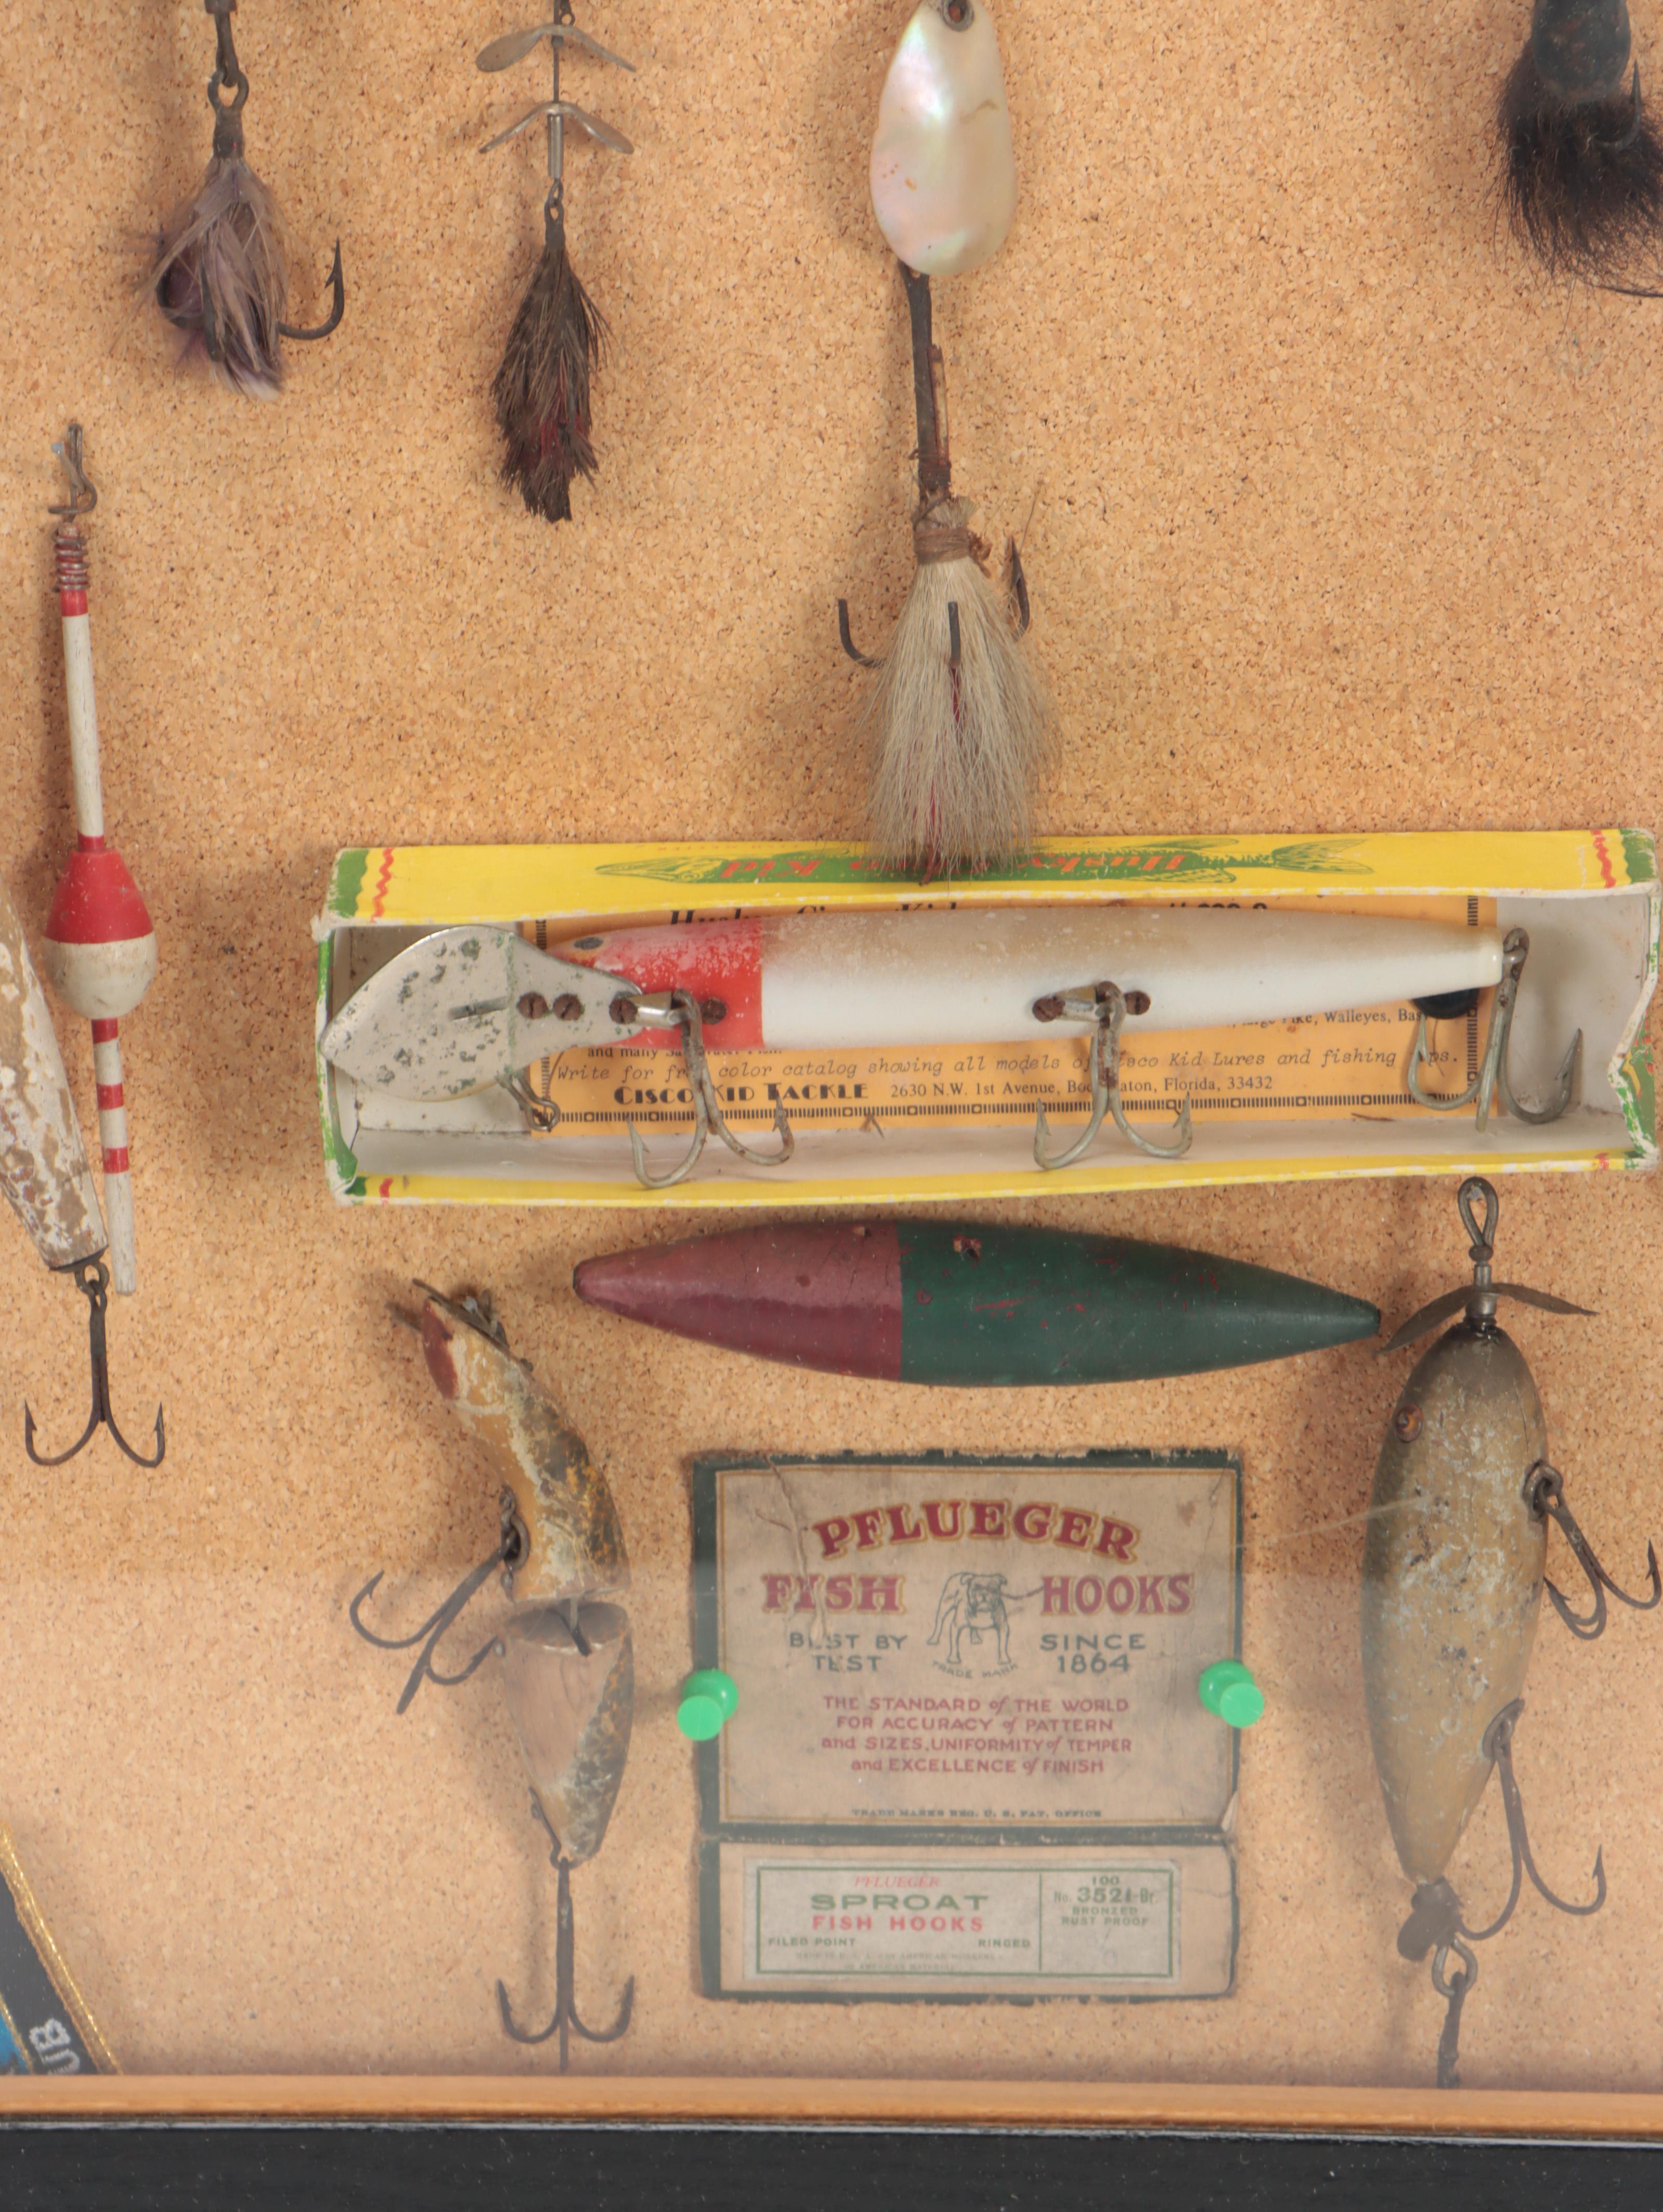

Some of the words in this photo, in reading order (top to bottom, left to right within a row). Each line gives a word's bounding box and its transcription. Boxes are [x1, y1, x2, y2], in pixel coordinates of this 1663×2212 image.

[720, 859, 823, 878] Kid
[1325, 1010, 1391, 1025] Walleyes,
[1398, 1008, 1427, 1021] Bas
[588, 1047, 613, 1058] and
[558, 1064, 610, 1080] Write
[623, 1066, 653, 1084] for
[665, 1064, 689, 1083] fr
[719, 1061, 772, 1078] color
[783, 1059, 857, 1079] catalog
[868, 1057, 943, 1077] showing
[954, 1056, 985, 1072] all
[996, 1054, 1060, 1071] models
[1169, 1051, 1205, 1066] Kid
[1213, 1051, 1265, 1066] Lures
[1277, 1048, 1311, 1065] and
[1321, 1047, 1397, 1068] fishing
[614, 1086, 693, 1105] CISCO
[763, 1082, 869, 1101] TACKLE
[891, 1084, 926, 1098] 2630
[933, 1082, 967, 1097] N.W.
[975, 1082, 994, 1095] 1st
[1002, 1081, 1060, 1096] Avenue,
[1067, 1079, 1092, 1092] Boc
[1120, 1080, 1158, 1094] aton,
[1164, 1077, 1221, 1092] Florida,
[1227, 1075, 1272, 1089] 33432
[812, 1500, 1139, 1561] PFLUEGER
[762, 1574, 906, 1614] FISH
[1041, 1574, 1194, 1615] HOOKS
[875, 1635, 908, 1650] BY
[1039, 1634, 1146, 1651] SINCE
[813, 1655, 882, 1672] TEST
[1058, 1652, 1131, 1674] 1864
[823, 1695, 860, 1710] THE
[869, 1696, 981, 1711] STANDARD
[988, 1695, 1010, 1716] of
[1014, 1698, 1052, 1713] THE
[1061, 1698, 1129, 1713] WORLD
[836, 1716, 874, 1730] FOR
[881, 1717, 993, 1731] ACCURACY
[1001, 1716, 1019, 1735] of
[1025, 1718, 1114, 1732] PATTERN
[821, 1736, 856, 1750] and
[930, 1738, 1042, 1753] UNIFORMITY
[1046, 1735, 1063, 1755] of
[1068, 1738, 1132, 1753] TEMPER
[851, 1759, 882, 1771] and
[888, 1758, 1017, 1773] EXCELLENCE
[1023, 1757, 1040, 1776] of
[1042, 1759, 1105, 1774] FINISH
[854, 1876, 942, 1889] PFLUEGER
[1092, 1875, 1120, 1886] 100
[810, 1893, 989, 1912] SPROAT
[1072, 1906, 1139, 1916] BRONZED
[812, 1915, 873, 1931] FISH
[889, 1916, 984, 1932] HOOKS
[1061, 1916, 1096, 1926] RUST
[1104, 1916, 1149, 1926] PROOF
[768, 1937, 808, 1947] FILED
[815, 1937, 856, 1947] POINT
[978, 1938, 1031, 1948] RINGED
